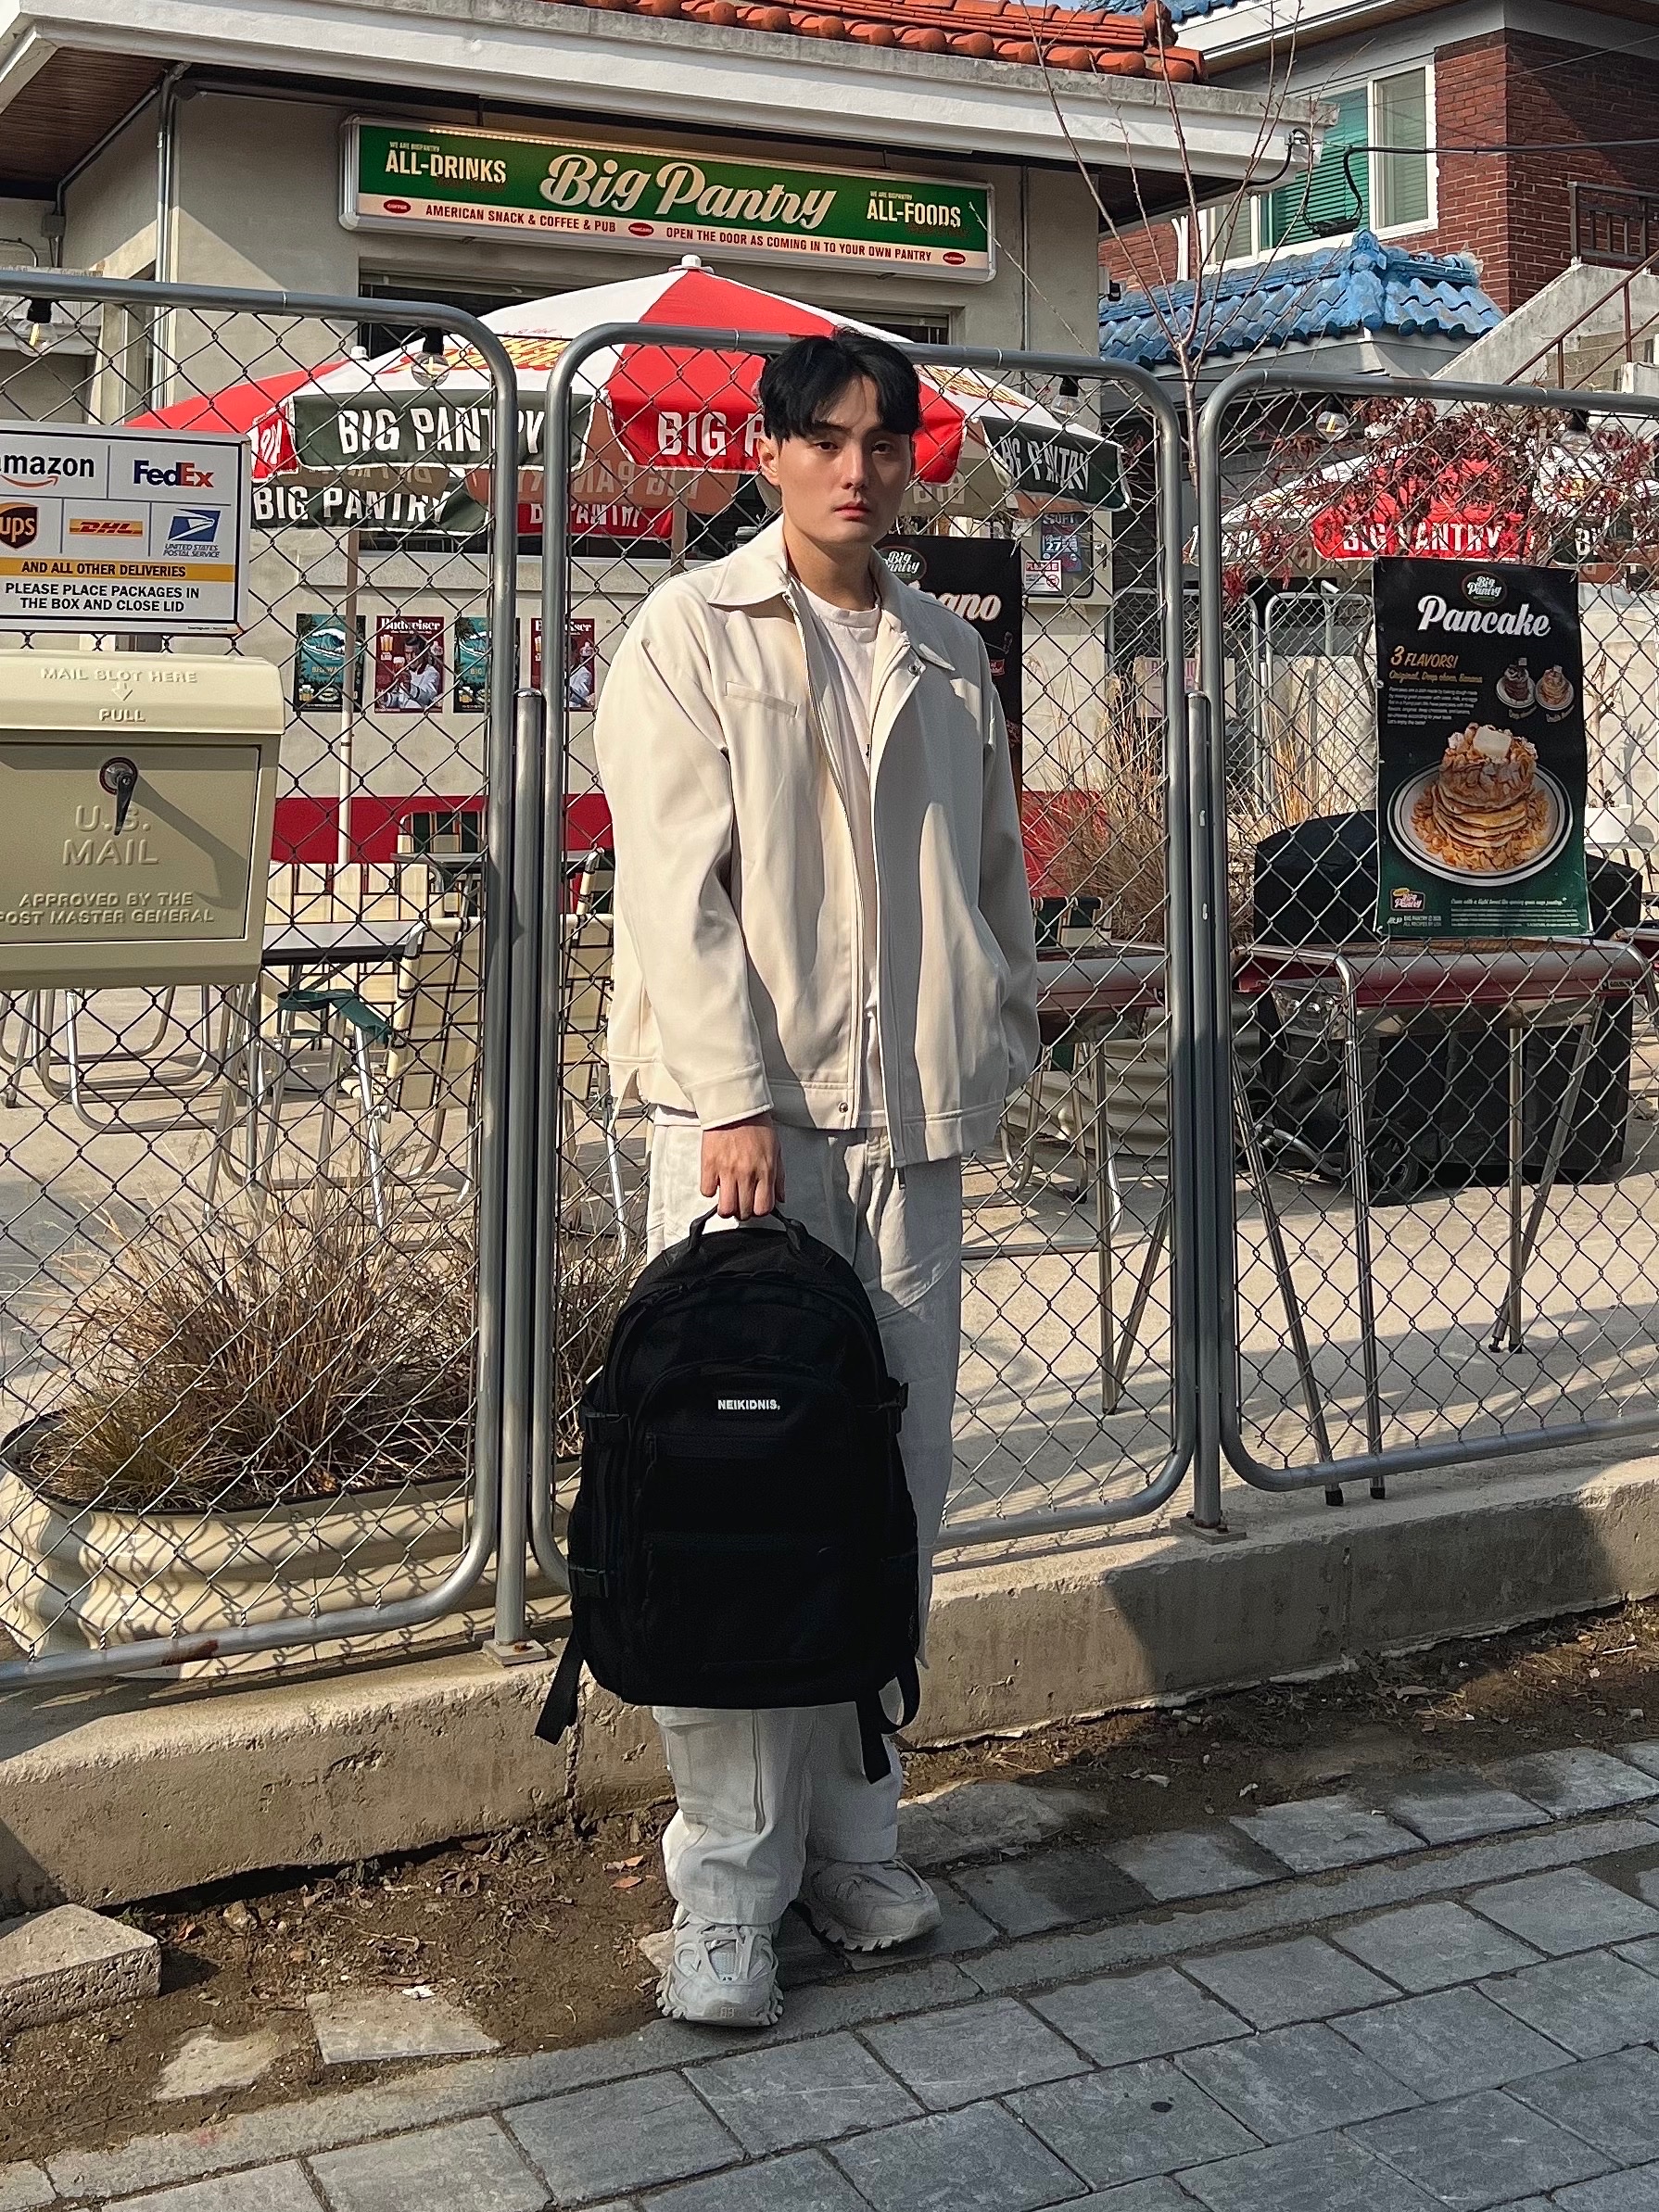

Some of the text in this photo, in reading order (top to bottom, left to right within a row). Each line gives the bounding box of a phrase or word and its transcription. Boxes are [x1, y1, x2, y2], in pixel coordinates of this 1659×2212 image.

[385, 149, 507, 184] ALL-DRINKS
[539, 153, 837, 229] Big Pantry
[425, 204, 484, 221] AMERICAN
[488, 209, 525, 224] SNACK
[527, 214, 536, 224] &
[539, 215, 580, 229] COFFEE
[583, 219, 591, 230] &
[594, 220, 616, 233] PUB
[867, 198, 961, 228] ALL-FOODS
[666, 226, 693, 239] OPEN
[696, 230, 716, 241] THE
[719, 232, 747, 245] DOOR
[750, 234, 764, 246] AS
[766, 236, 807, 251] COMING
[810, 240, 820, 252] IN
[823, 241, 835, 253] TO
[839, 243, 866, 256] YOUR
[868, 246, 892, 259] OWN
[894, 247, 932, 261] PANTRY
[337, 408, 400, 454] BIG
[658, 411, 727, 458] BIG
[0, 453, 214, 488] mazon FedEx
[252, 486, 309, 521] BIG
[0, 516, 35, 543] ups
[79, 521, 136, 534] DHL
[21, 561, 186, 577] AND ALL OTHER DELIVERIES
[6, 582, 200, 599] PLEASE PLACE PACKAGES IN
[20, 597, 184, 612] THE BOX AND CLOSE LID
[1417, 595, 1551, 638] Pancake
[1390, 645, 1459, 668] 3 FLAVORS!
[41, 667, 89, 681] MAIL
[148, 670, 197, 684] HERE
[98, 708, 146, 723] PULL
[74, 803, 151, 832] U.S.
[61, 838, 160, 866] MAIL
[19, 891, 194, 908] APPROVED BY THE
[49, 910, 125, 925] MASTER
[131, 908, 215, 924] GENERAL
